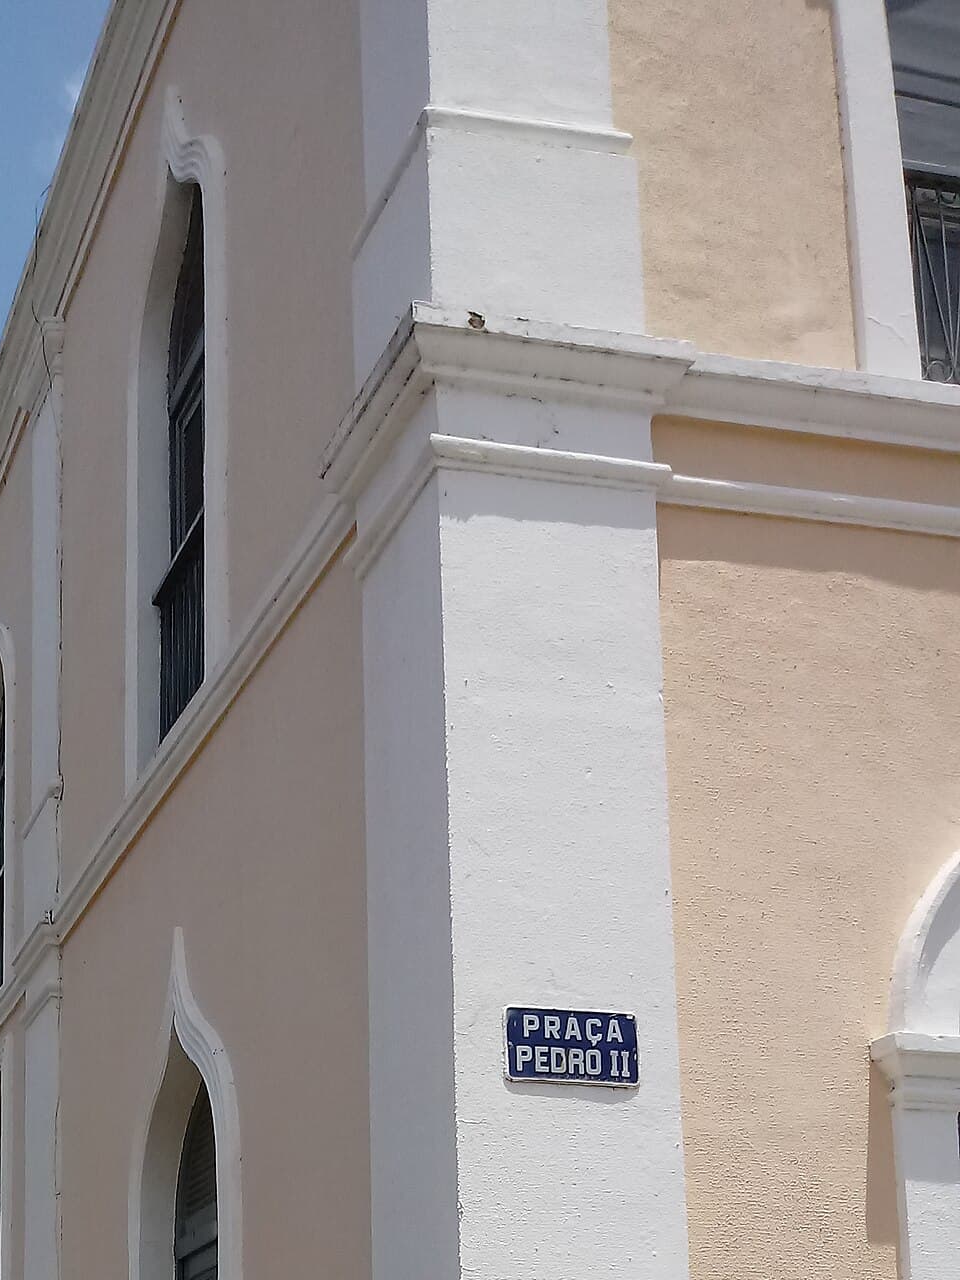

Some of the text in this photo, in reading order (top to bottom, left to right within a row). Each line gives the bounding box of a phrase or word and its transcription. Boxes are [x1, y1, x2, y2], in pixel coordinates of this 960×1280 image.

[523, 1015, 623, 1046] PRAÇA
[516, 1046, 631, 1077] PEDRO II
